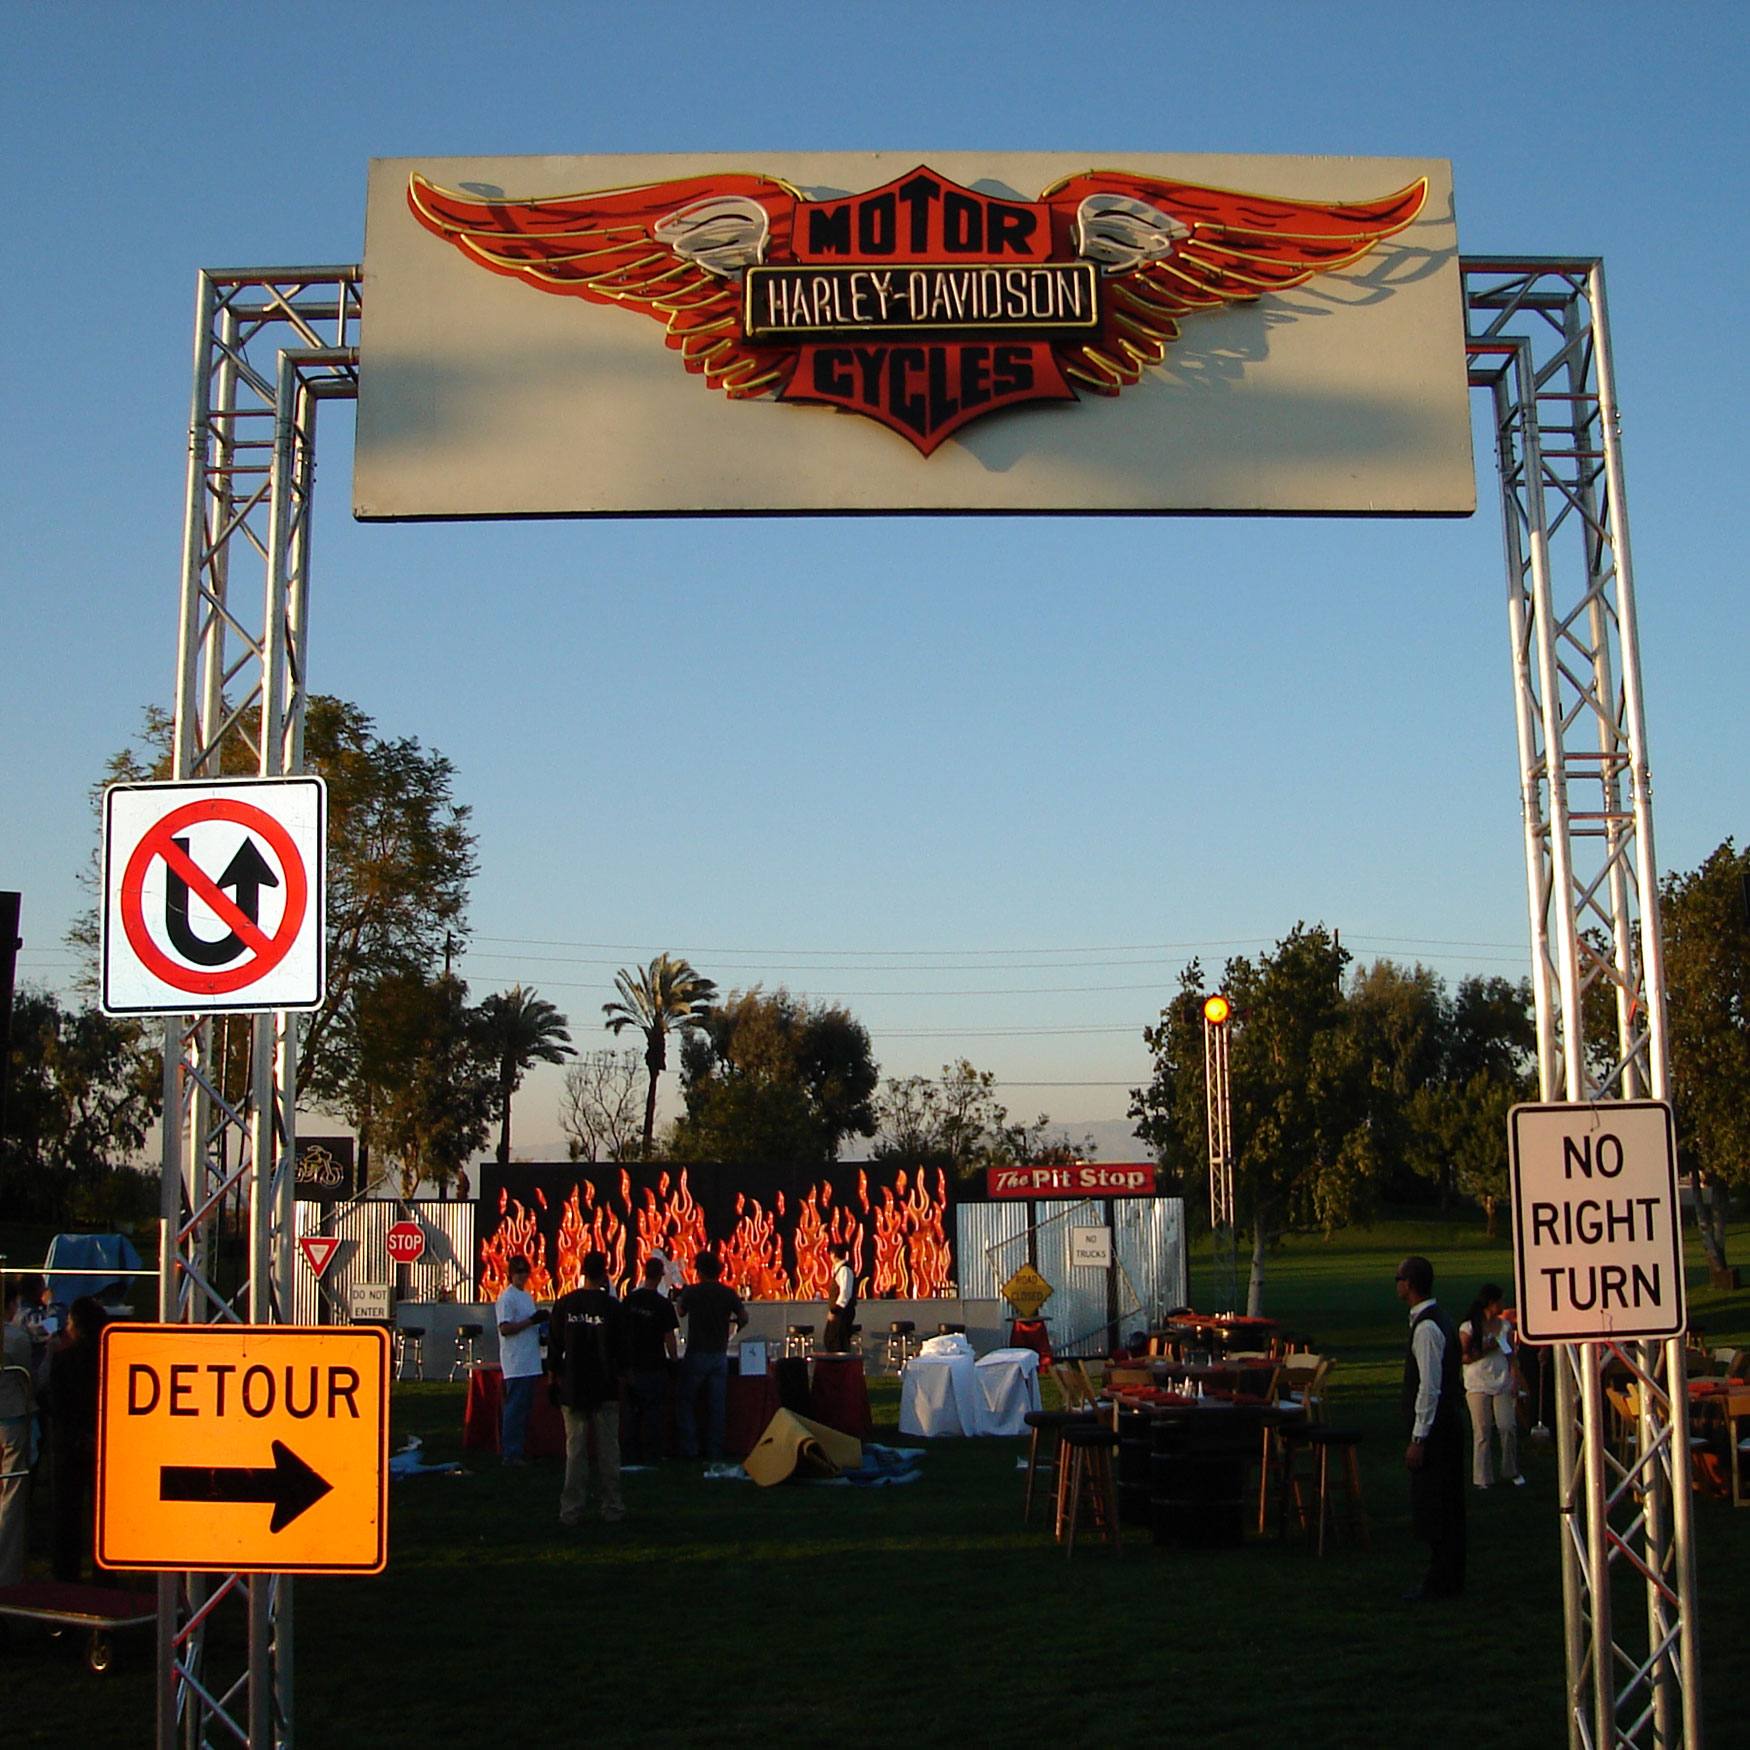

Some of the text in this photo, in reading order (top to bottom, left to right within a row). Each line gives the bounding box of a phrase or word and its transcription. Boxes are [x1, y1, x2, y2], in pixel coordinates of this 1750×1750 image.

[808, 175, 1038, 255] MOTOR
[767, 269, 1083, 327] HARLEY-DAVIDSON
[812, 346, 1034, 438] CYCLES
[1562, 1133, 1624, 1179] NO
[995, 1168, 1146, 1191] The Pit Stop
[388, 1234, 423, 1250] STOP
[1085, 1234, 1097, 1244] NO
[1531, 1198, 1661, 1246] RIGHT
[1076, 1249, 1106, 1258] TRUCKS
[352, 1289, 387, 1300] DO NOT
[1540, 1263, 1662, 1312] TURN
[354, 1307, 385, 1317] ENTER
[128, 1363, 360, 1419] DETOUR
